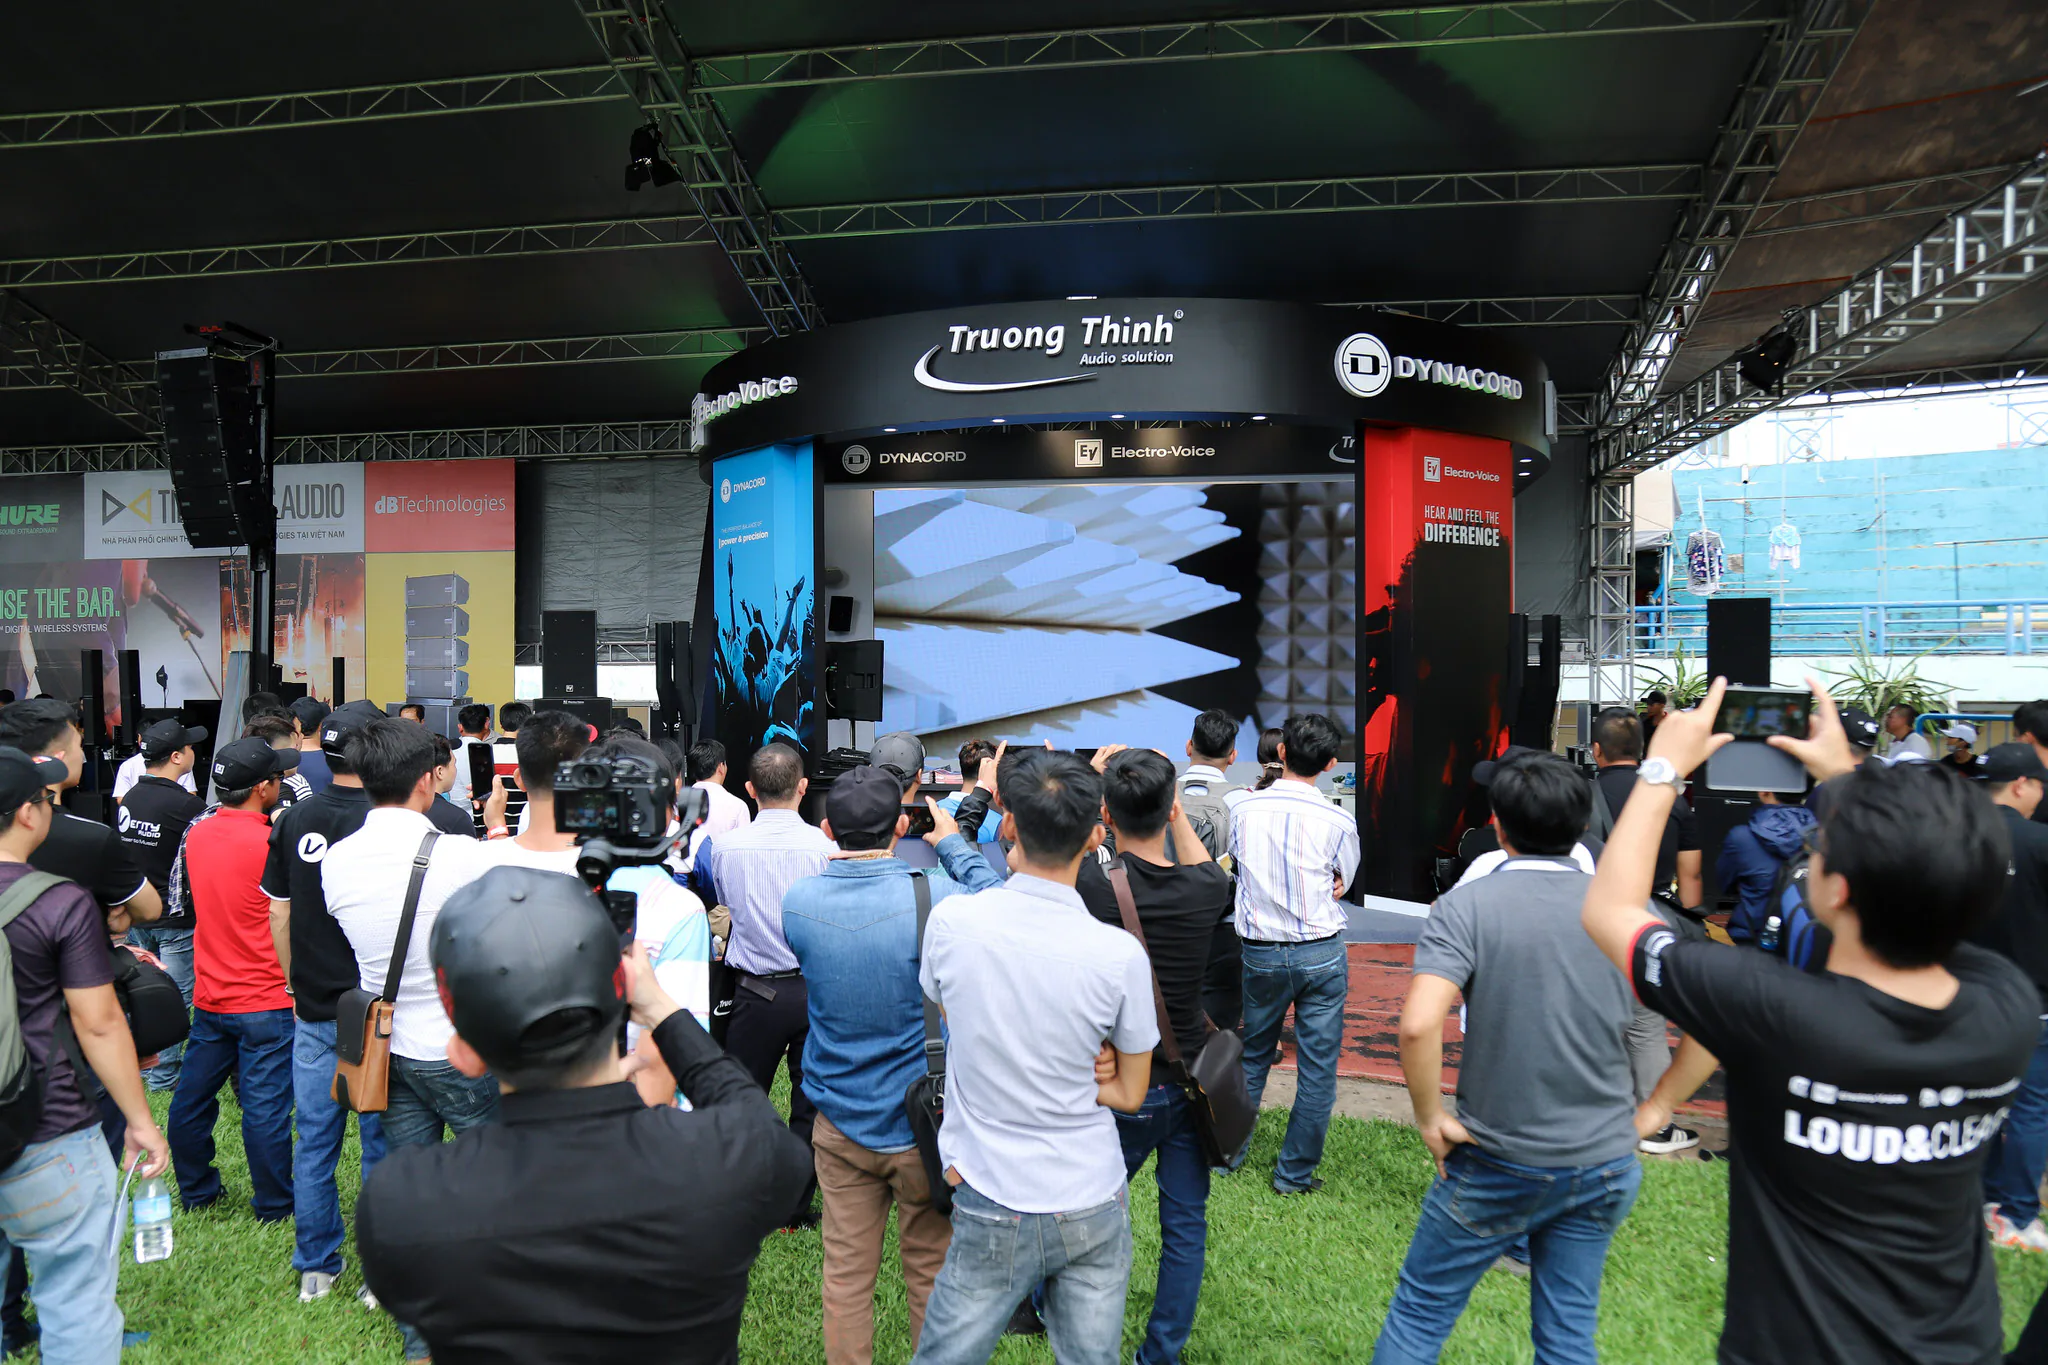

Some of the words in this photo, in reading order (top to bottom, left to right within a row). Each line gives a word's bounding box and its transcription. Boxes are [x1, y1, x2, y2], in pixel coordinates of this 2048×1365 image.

[948, 324, 1065, 356] Truong
[1079, 353, 1117, 367] Audio
[1121, 349, 1174, 365] solution
[1393, 355, 1523, 400] DYNACORD
[879, 451, 967, 464] DYNACORD
[1111, 445, 1216, 459] Electro-Voice
[1444, 465, 1500, 482] Electro-Voice
[734, 477, 766, 493] DYNACORD
[280, 483, 345, 520] AUDIO
[374, 494, 507, 517] dBTechnologies
[1424, 505, 1446, 520] HEAR
[1447, 507, 1463, 522] AND
[1465, 508, 1484, 524] FEEL
[1485, 510, 1500, 525] THE
[328, 530, 345, 538] NAM
[743, 531, 769, 544] precision
[1424, 522, 1500, 547] DIFFERENCE
[34, 588, 71, 619] THE
[77, 586, 121, 618] BAR.
[5, 625, 32, 634] DIGITAL
[34, 624, 71, 633] WIRELESS
[72, 623, 108, 632] SYSTEMS
